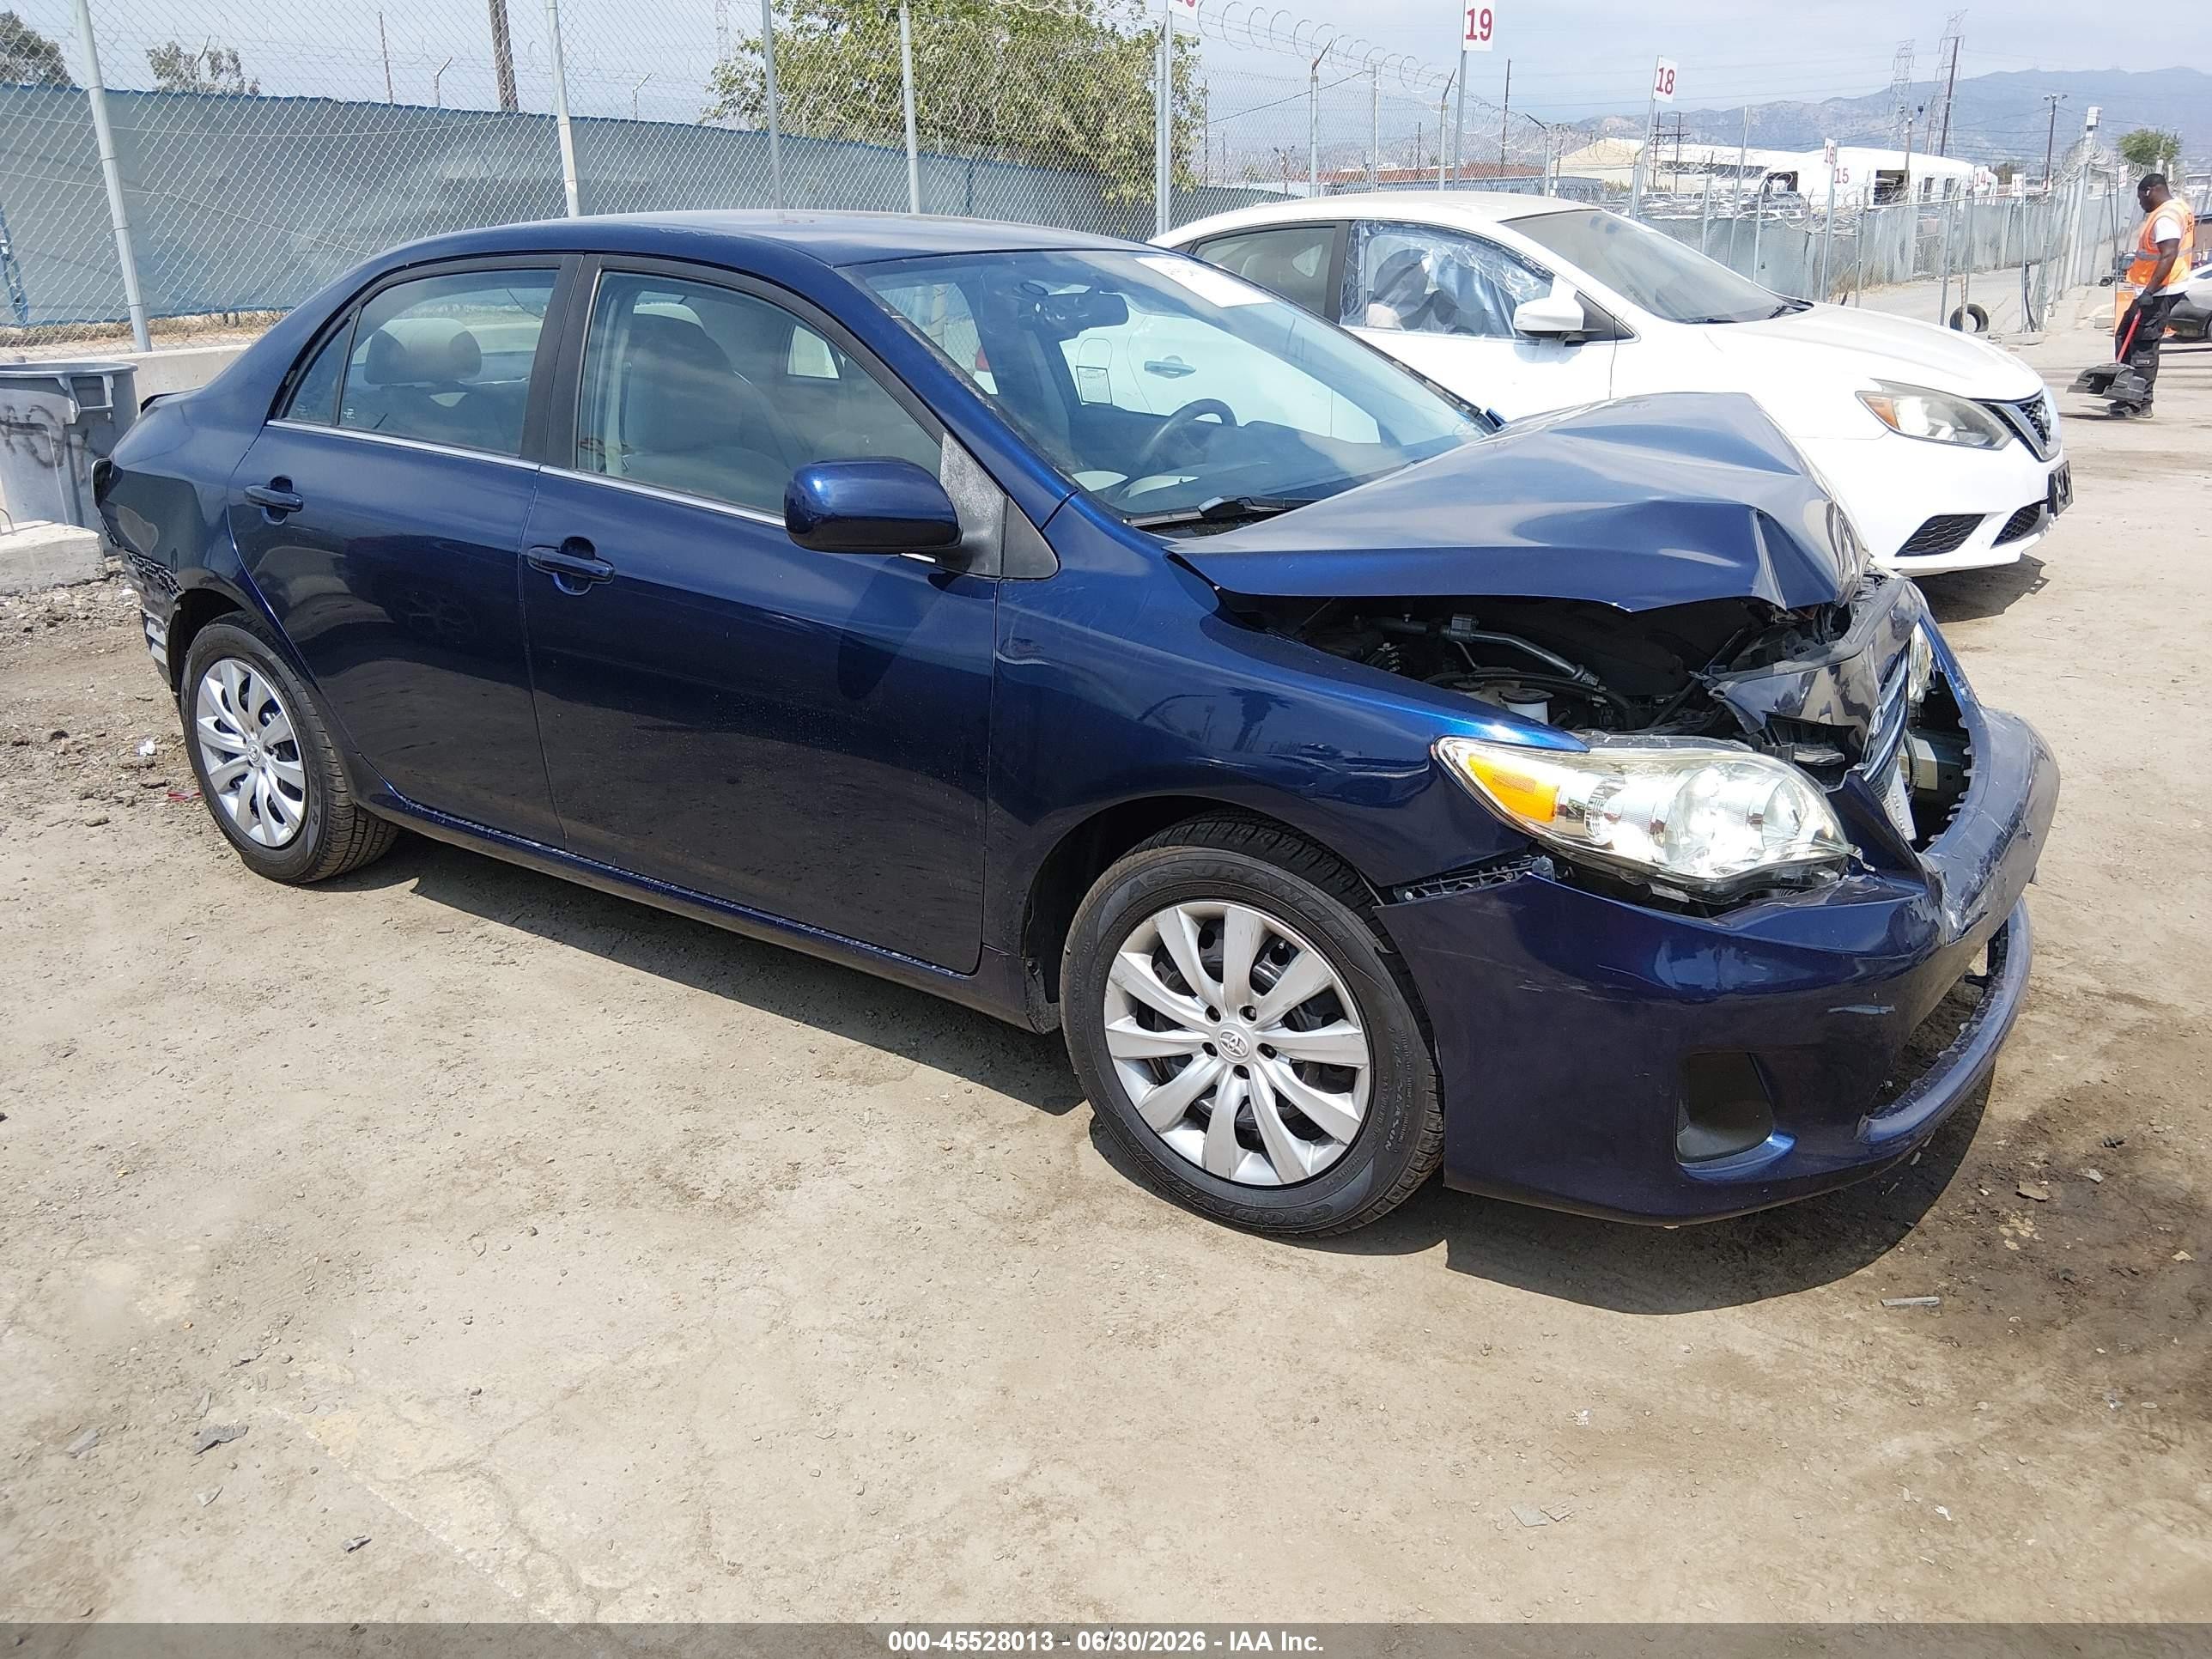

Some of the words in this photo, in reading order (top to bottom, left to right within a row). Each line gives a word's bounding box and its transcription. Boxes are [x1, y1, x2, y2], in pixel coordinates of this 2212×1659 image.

[1466, 8, 1492, 41] 19
[1656, 67, 1675, 95] 18
[1824, 145, 1834, 166] 16
[1835, 168, 1850, 185] 15
[1974, 171, 1987, 187] 14
[1127, 862, 1351, 943] ASSURANCE
[1129, 1142, 1334, 1226] GOODYEAR
